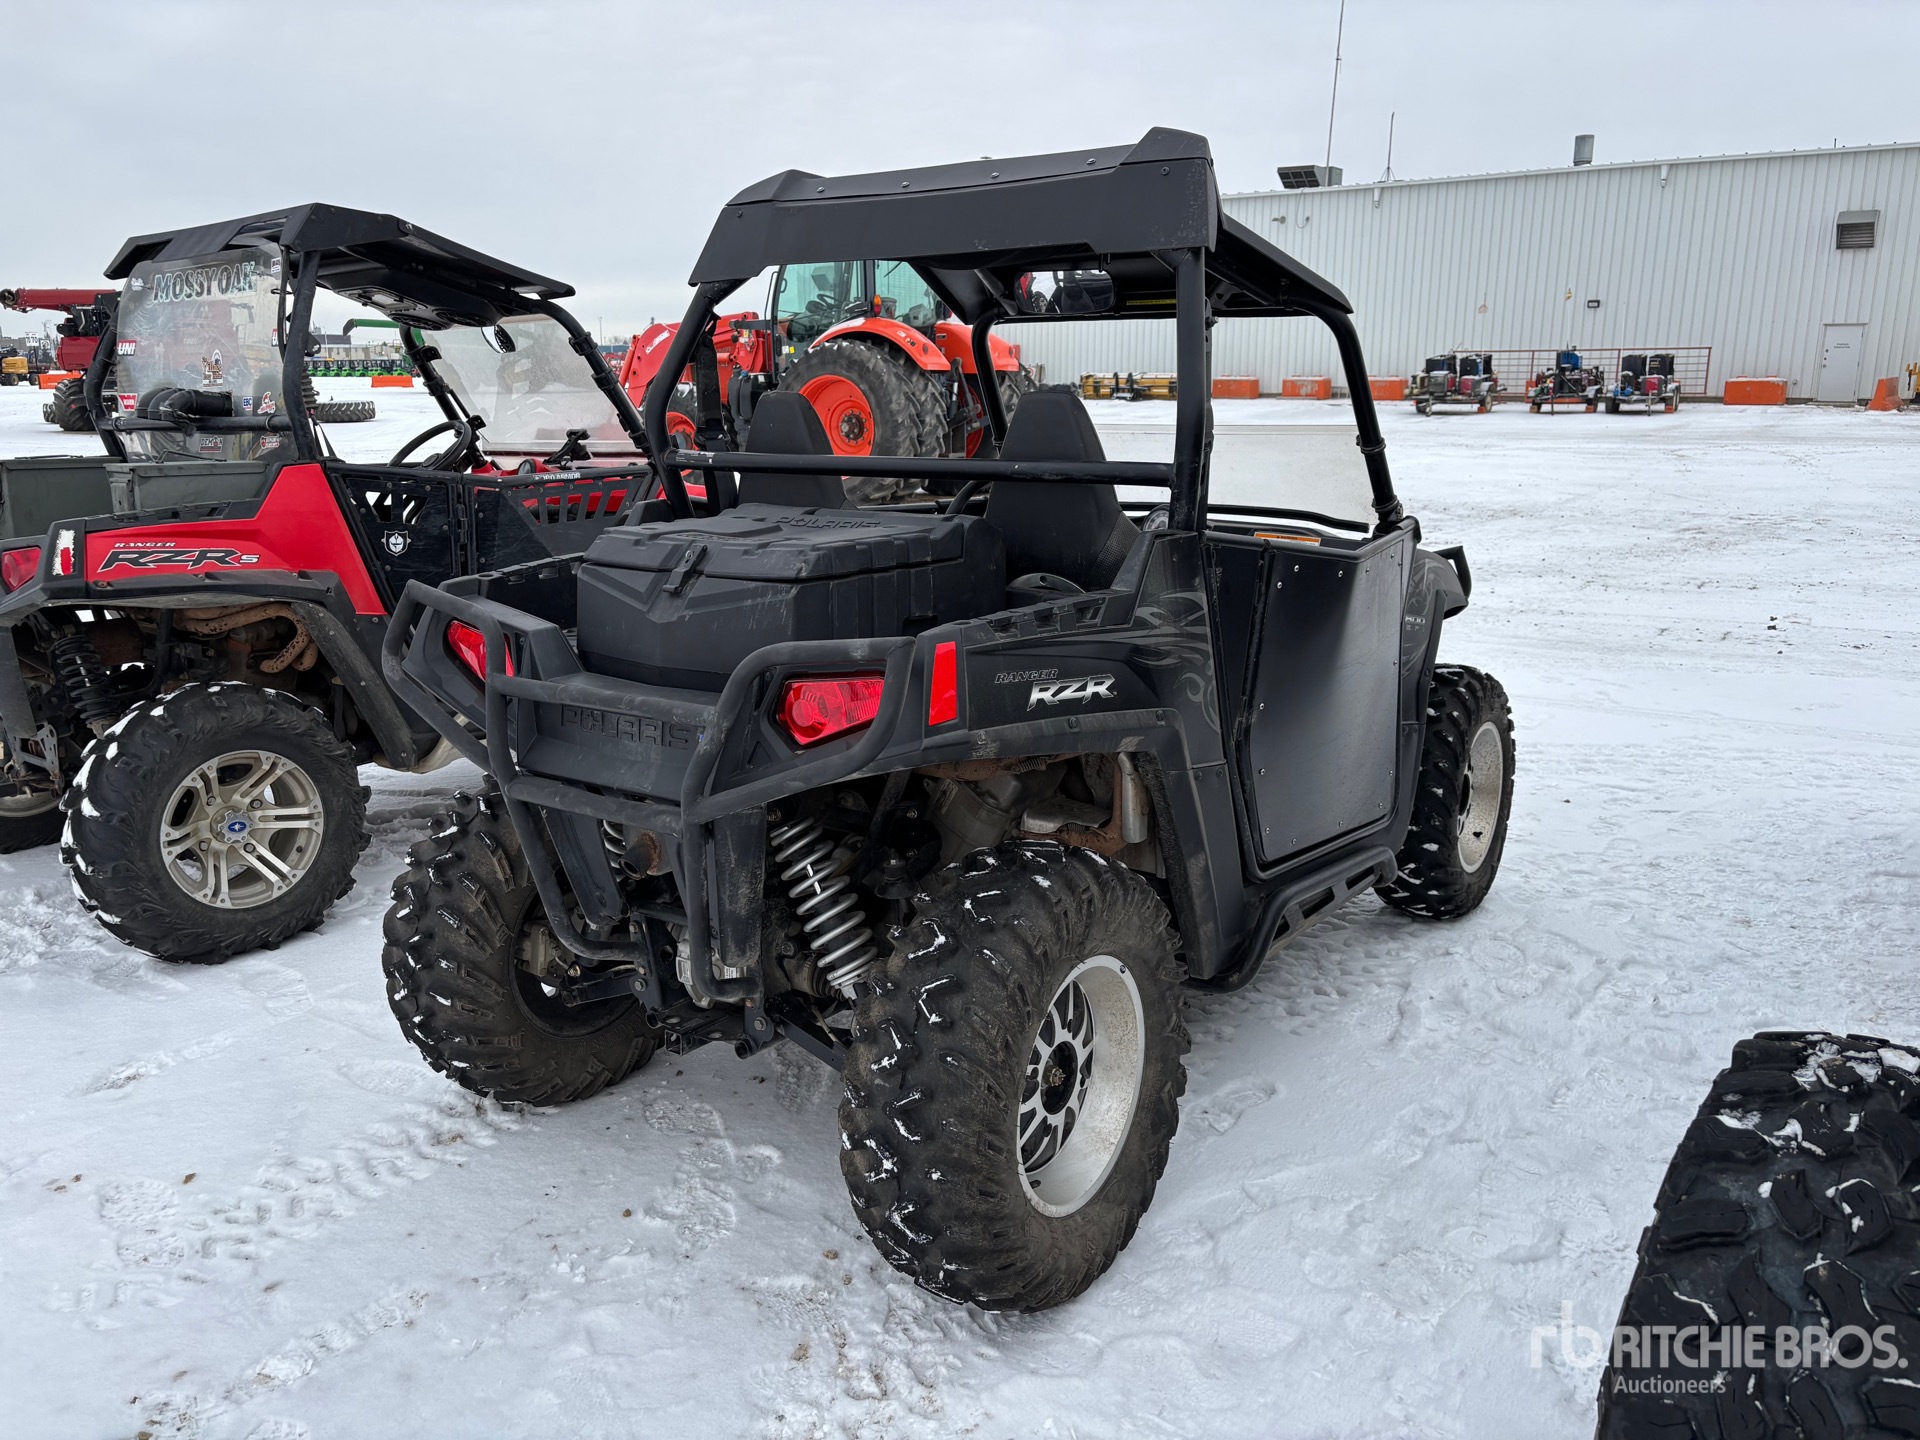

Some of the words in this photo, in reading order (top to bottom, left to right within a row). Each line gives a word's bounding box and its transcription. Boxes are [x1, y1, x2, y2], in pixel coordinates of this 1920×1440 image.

[153, 268, 217, 303] MOSSY
[217, 261, 257, 295] OAK
[117, 342, 136, 355] UNI
[771, 516, 881, 530] POLARIS
[994, 668, 1059, 684] RANGER
[1026, 673, 1116, 712] RZR
[560, 702, 693, 750] POLARIS
